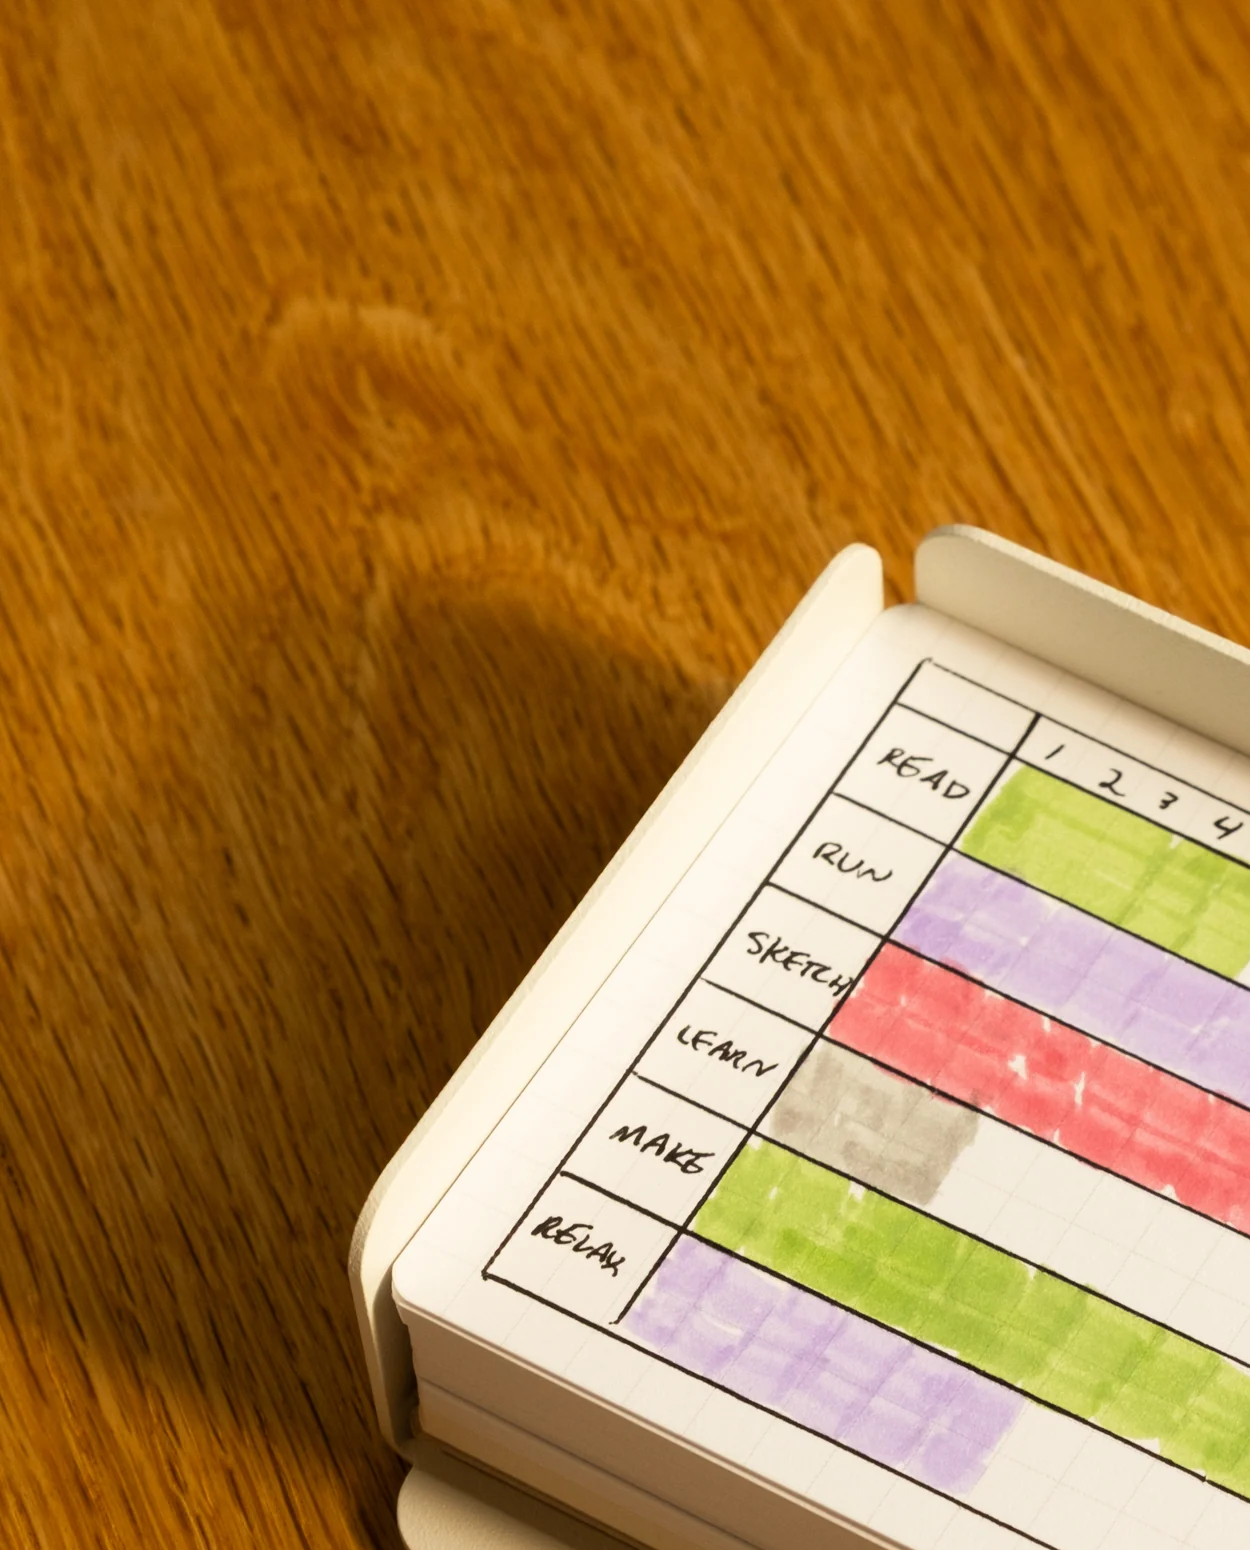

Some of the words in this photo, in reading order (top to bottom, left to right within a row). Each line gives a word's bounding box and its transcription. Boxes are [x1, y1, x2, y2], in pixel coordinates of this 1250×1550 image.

[876, 747, 971, 801] READ
[1099, 769, 1125, 797] 2
[1158, 791, 1179, 810] 3
[1213, 816, 1243, 840] 4
[812, 842, 893, 883] RUN
[746, 930, 852, 996] SKETCH
[676, 1025, 779, 1077] LEARN
[609, 1125, 716, 1174] MAKE
[531, 1215, 626, 1277] RELAX
